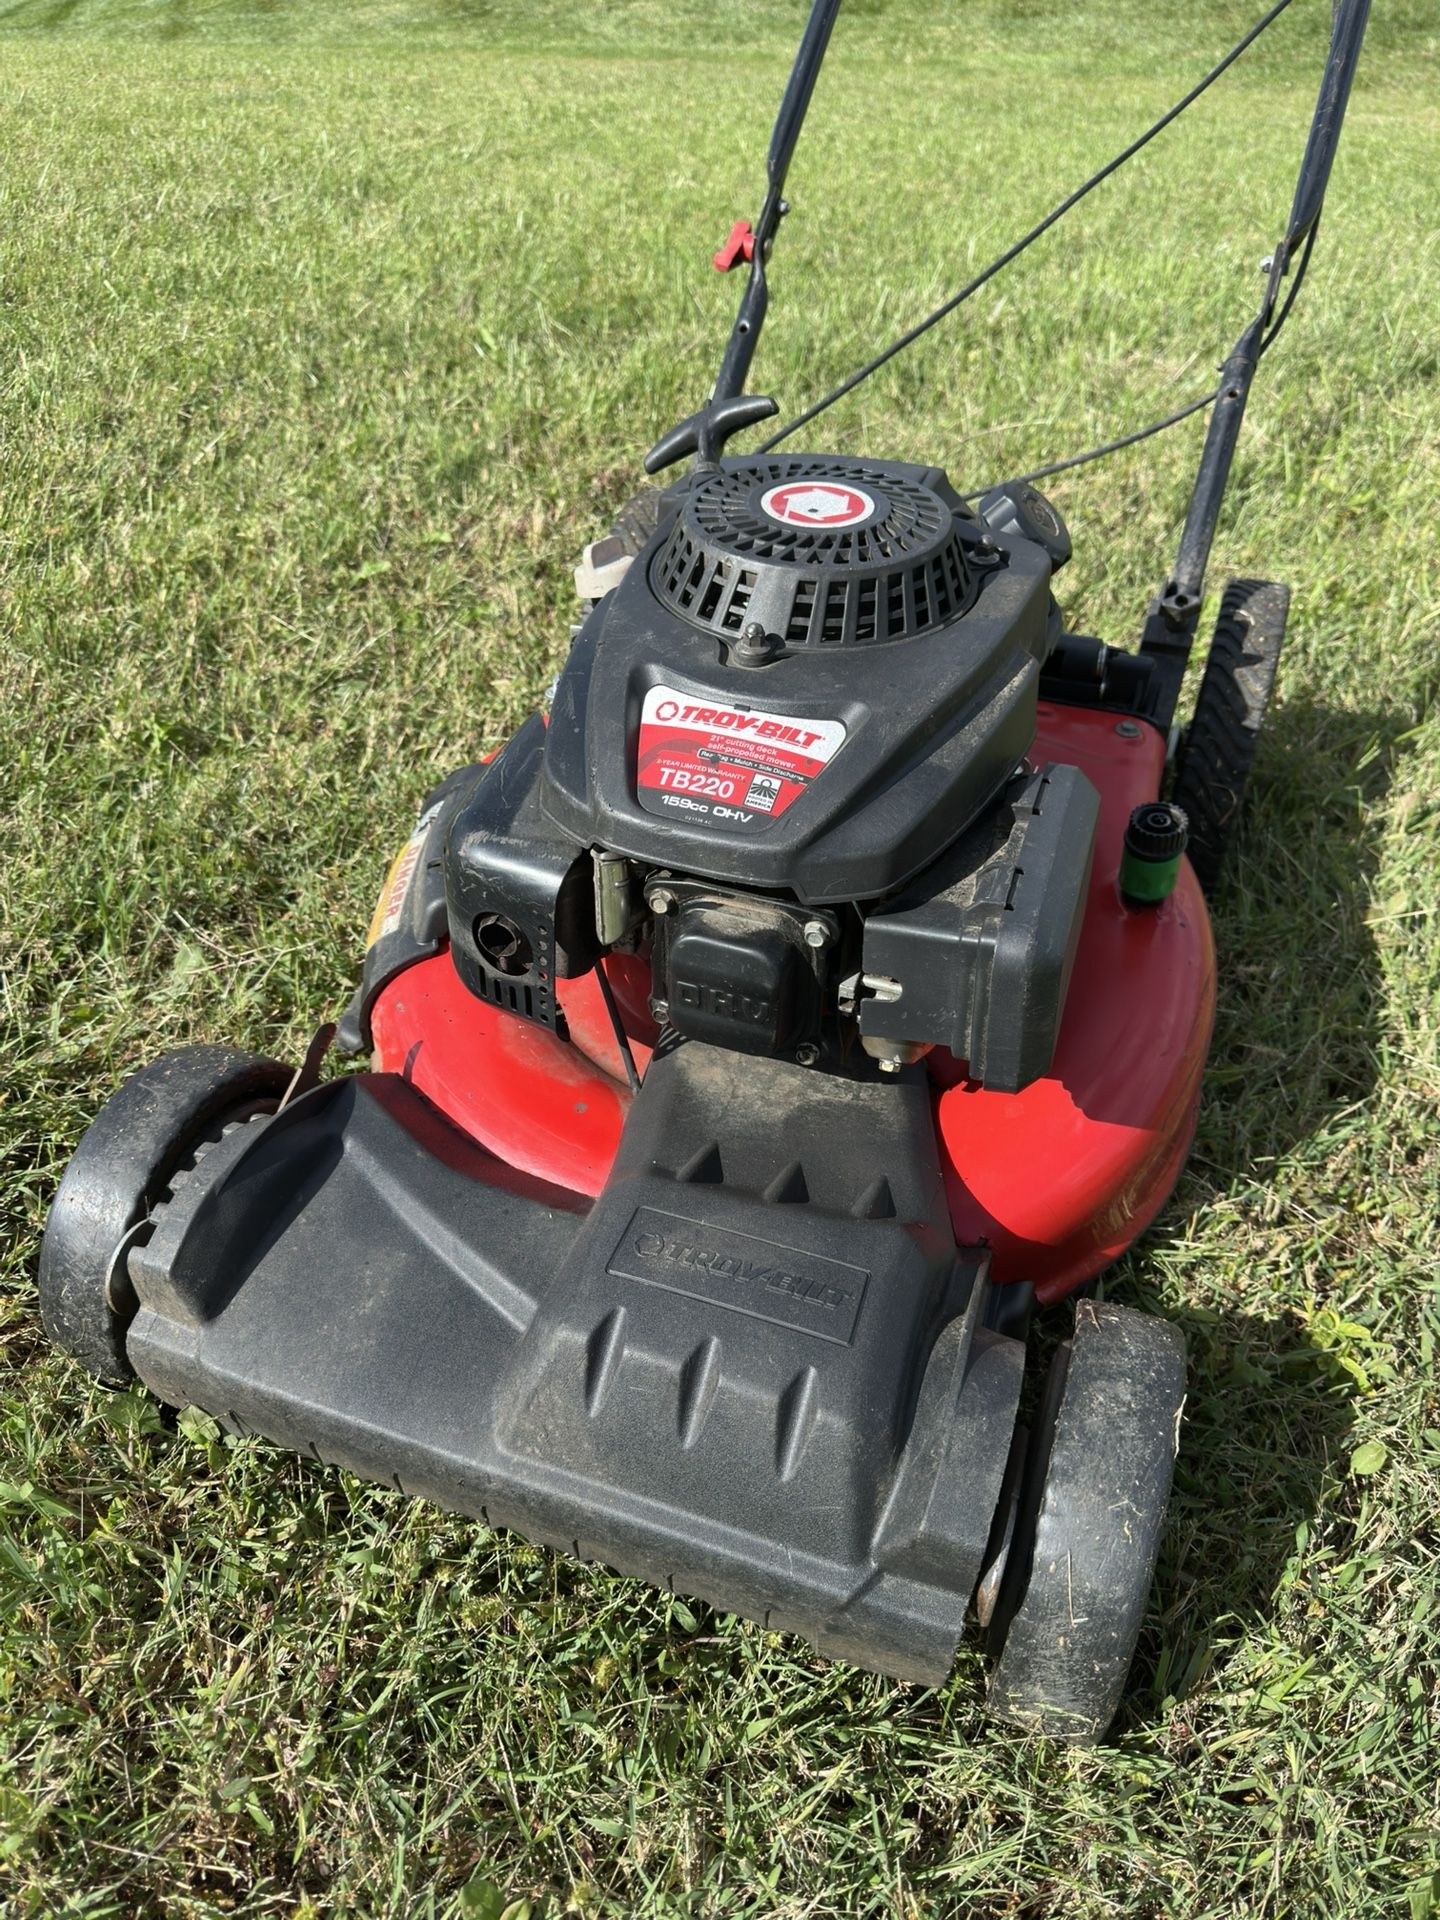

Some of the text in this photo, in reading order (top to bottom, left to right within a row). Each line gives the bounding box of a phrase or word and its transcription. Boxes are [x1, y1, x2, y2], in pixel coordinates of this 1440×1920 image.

[678, 705, 823, 749] TROY-BILT
[707, 742, 796, 769] self-propelled mower
[725, 737, 755, 750] cutting
[757, 744, 778, 756] deck
[656, 758, 746, 780] 2-YEAR LIMITED WARRANTY
[734, 757, 753, 767] Mulch
[758, 763, 772, 772] Side
[660, 767, 735, 798] TB220
[661, 794, 709, 813] 159cc
[712, 805, 754, 823] OHV
[387, 844, 422, 918] DANGER
